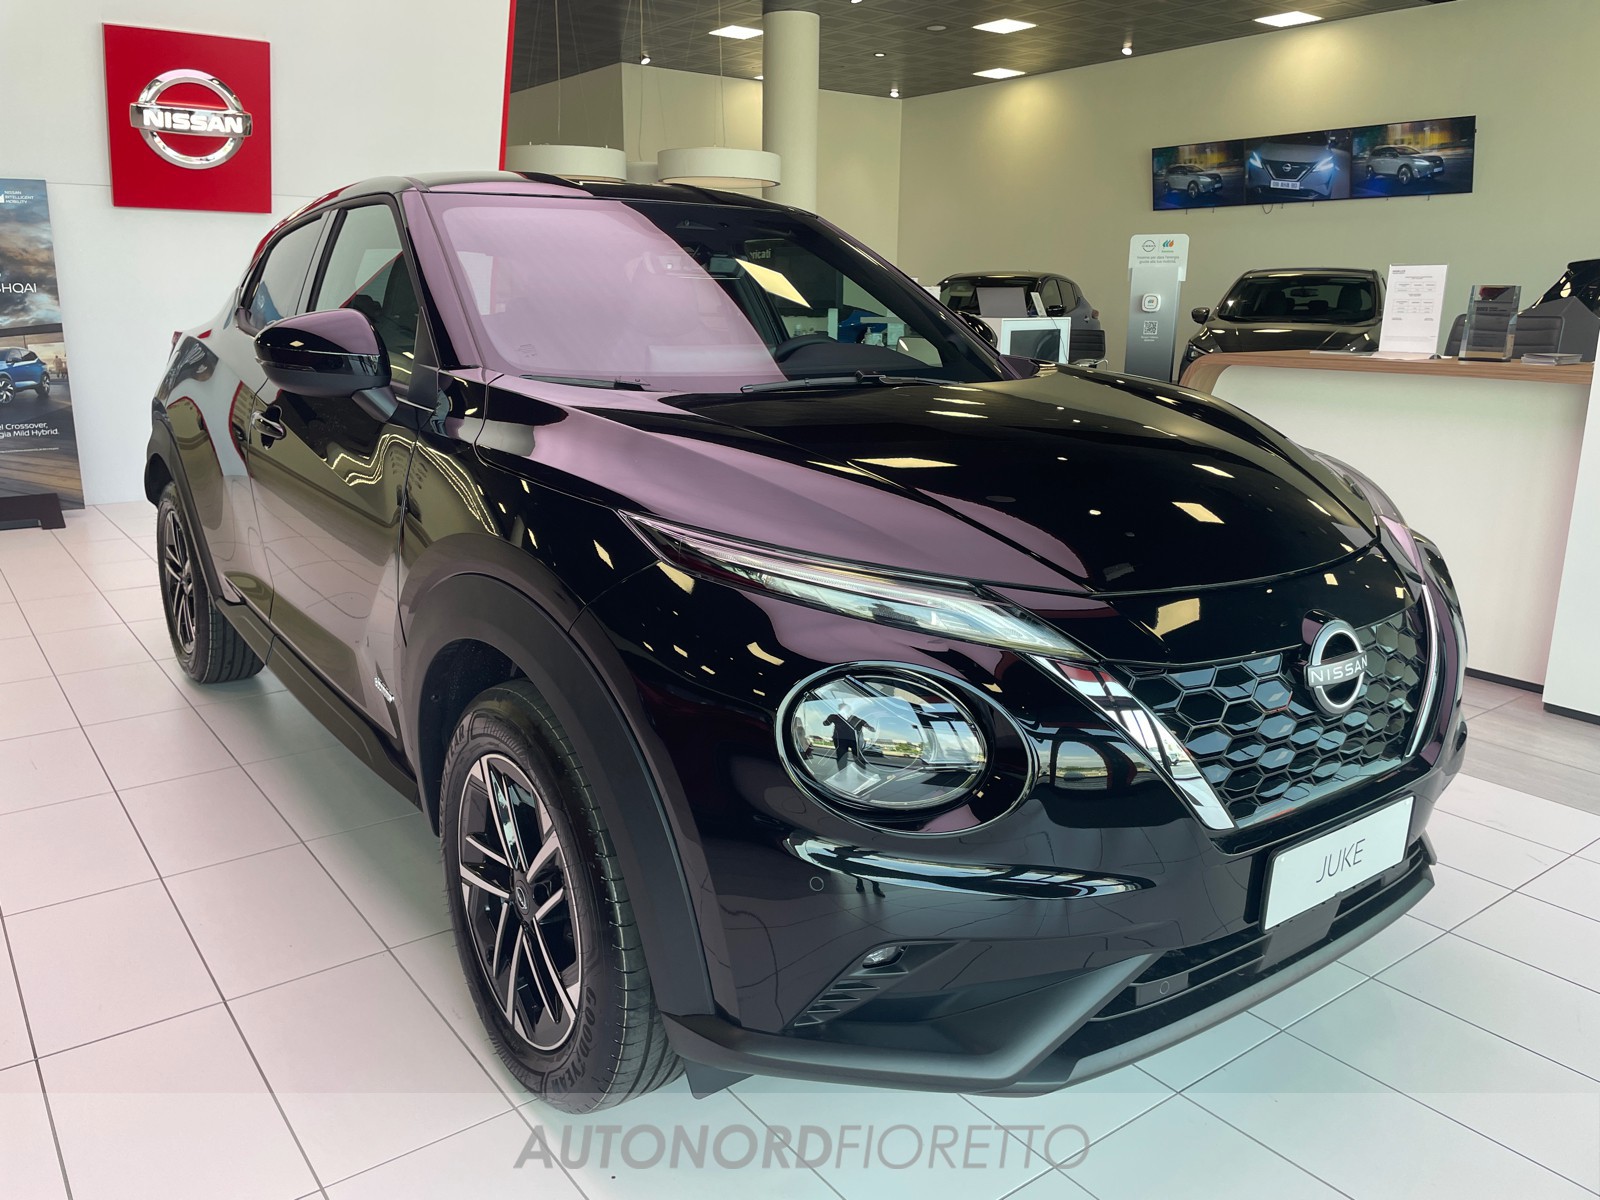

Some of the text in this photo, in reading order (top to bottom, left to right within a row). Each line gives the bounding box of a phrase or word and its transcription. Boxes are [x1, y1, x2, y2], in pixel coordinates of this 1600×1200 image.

[143, 109, 243, 134] NISSAN
[0, 282, 37, 294] HQAI
[5, 422, 49, 430] Crossover,
[31, 428, 60, 437] Hybrid.
[1311, 654, 1368, 684] NISSAN
[1316, 838, 1366, 883] JUKE
[551, 986, 597, 1093] GOODYEAR
